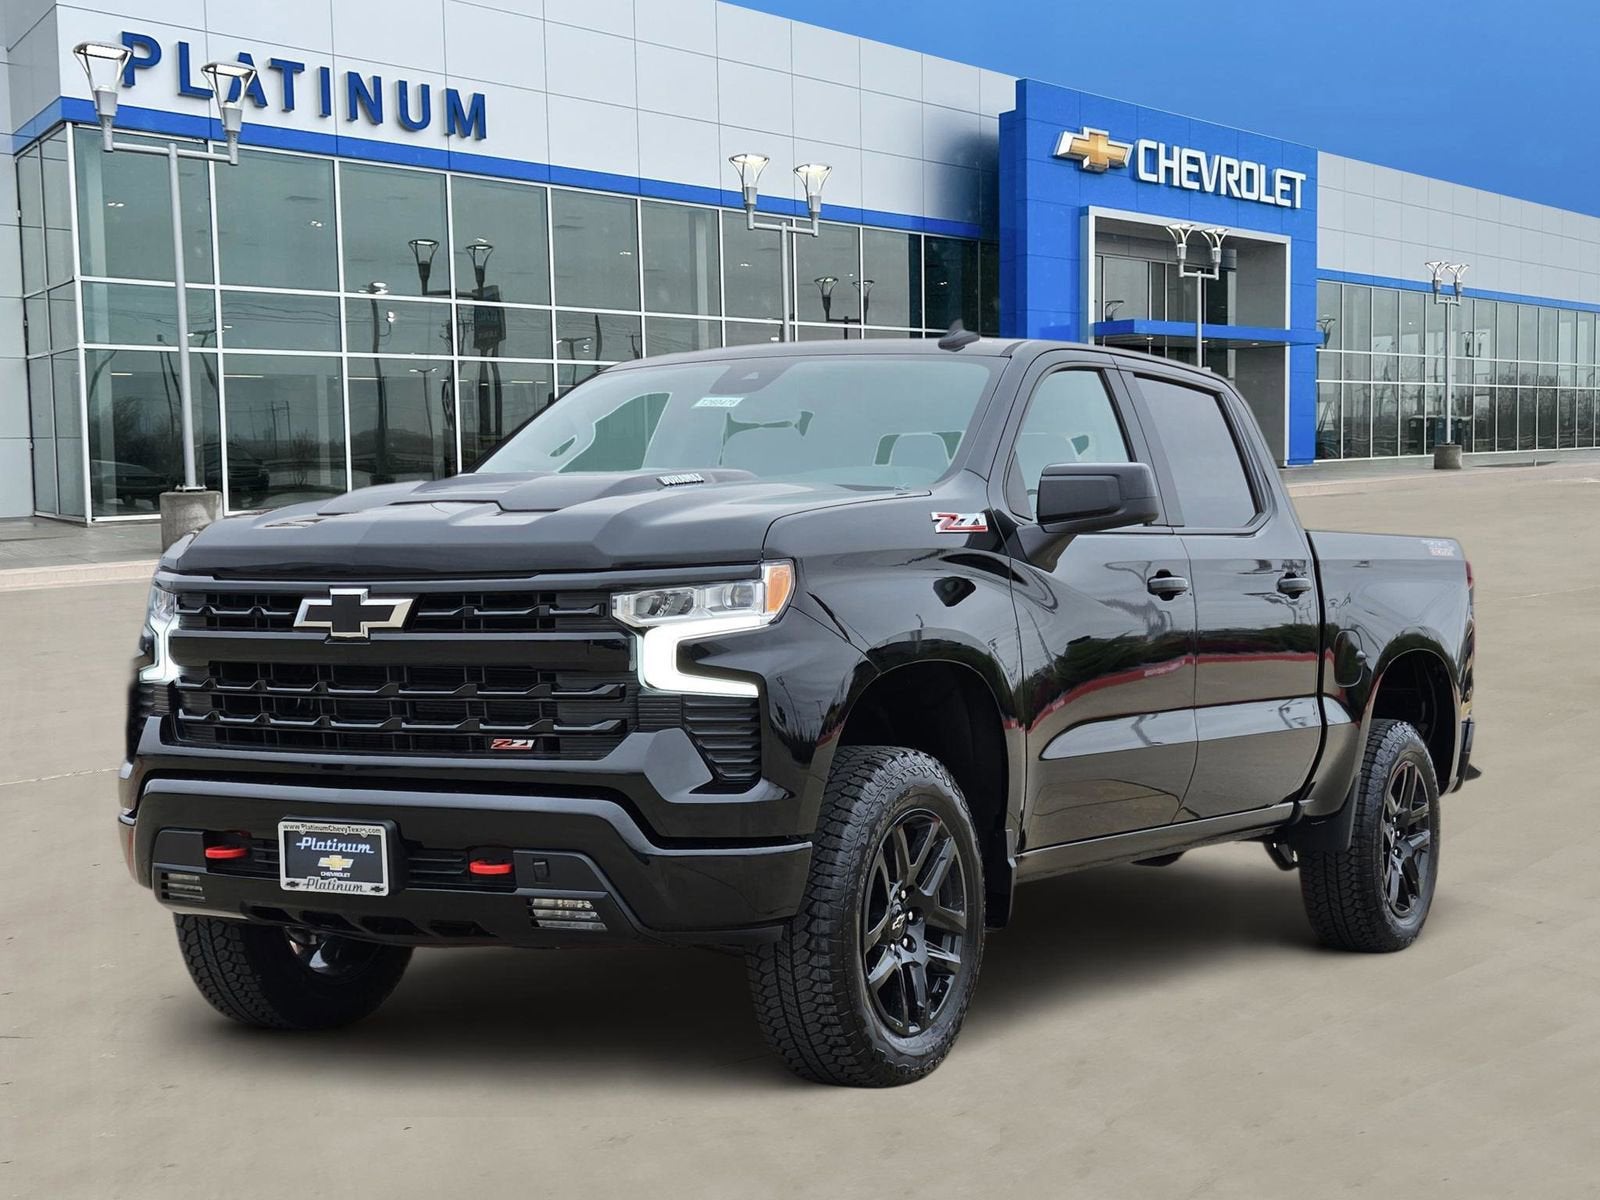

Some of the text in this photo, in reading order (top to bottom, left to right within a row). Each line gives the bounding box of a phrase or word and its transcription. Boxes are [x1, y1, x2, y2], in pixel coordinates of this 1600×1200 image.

[121, 31, 487, 141] PLATINUM
[1136, 138, 1307, 209] CHEVROLET
[931, 511, 988, 534] Z71
[490, 738, 535, 750] Z71
[296, 837, 374, 854] Platinum
[303, 877, 366, 893] Platinum
